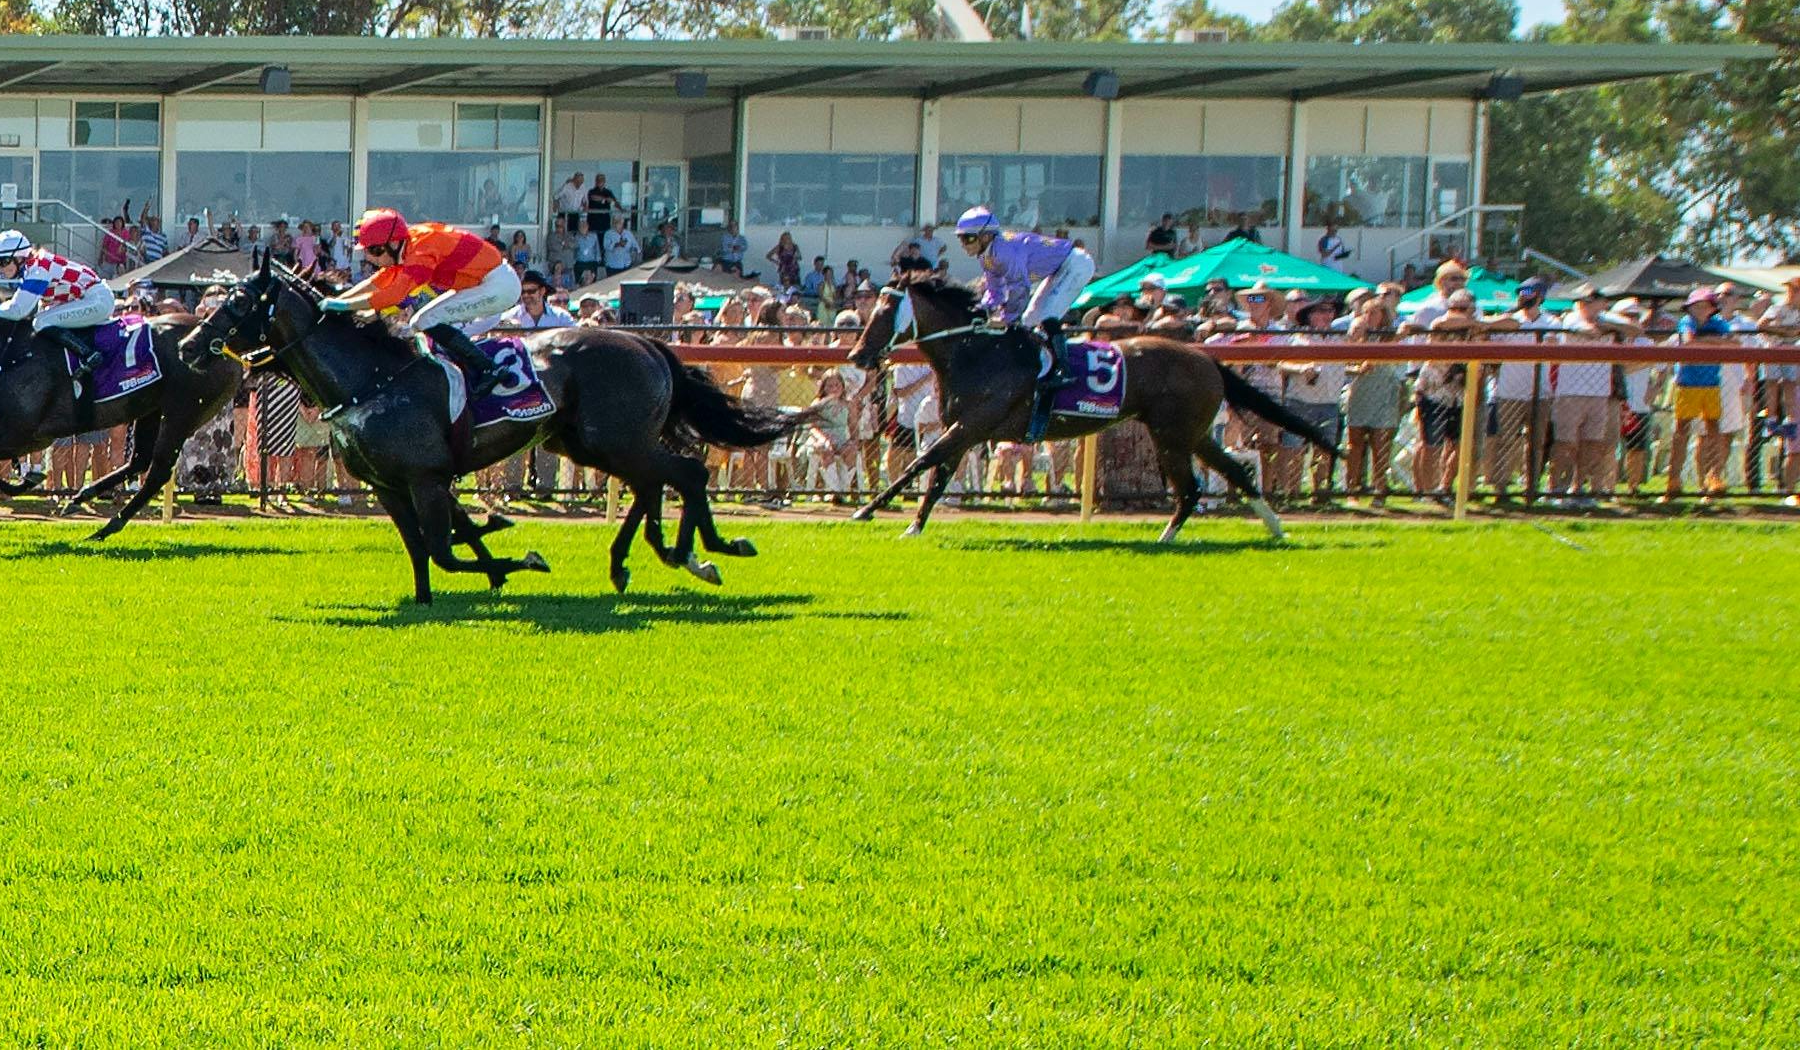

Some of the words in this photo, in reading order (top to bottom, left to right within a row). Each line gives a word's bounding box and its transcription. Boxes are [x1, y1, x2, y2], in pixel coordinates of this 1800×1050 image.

[118, 323, 143, 368] 7
[491, 347, 532, 396] 3
[1087, 350, 1120, 394] 5
